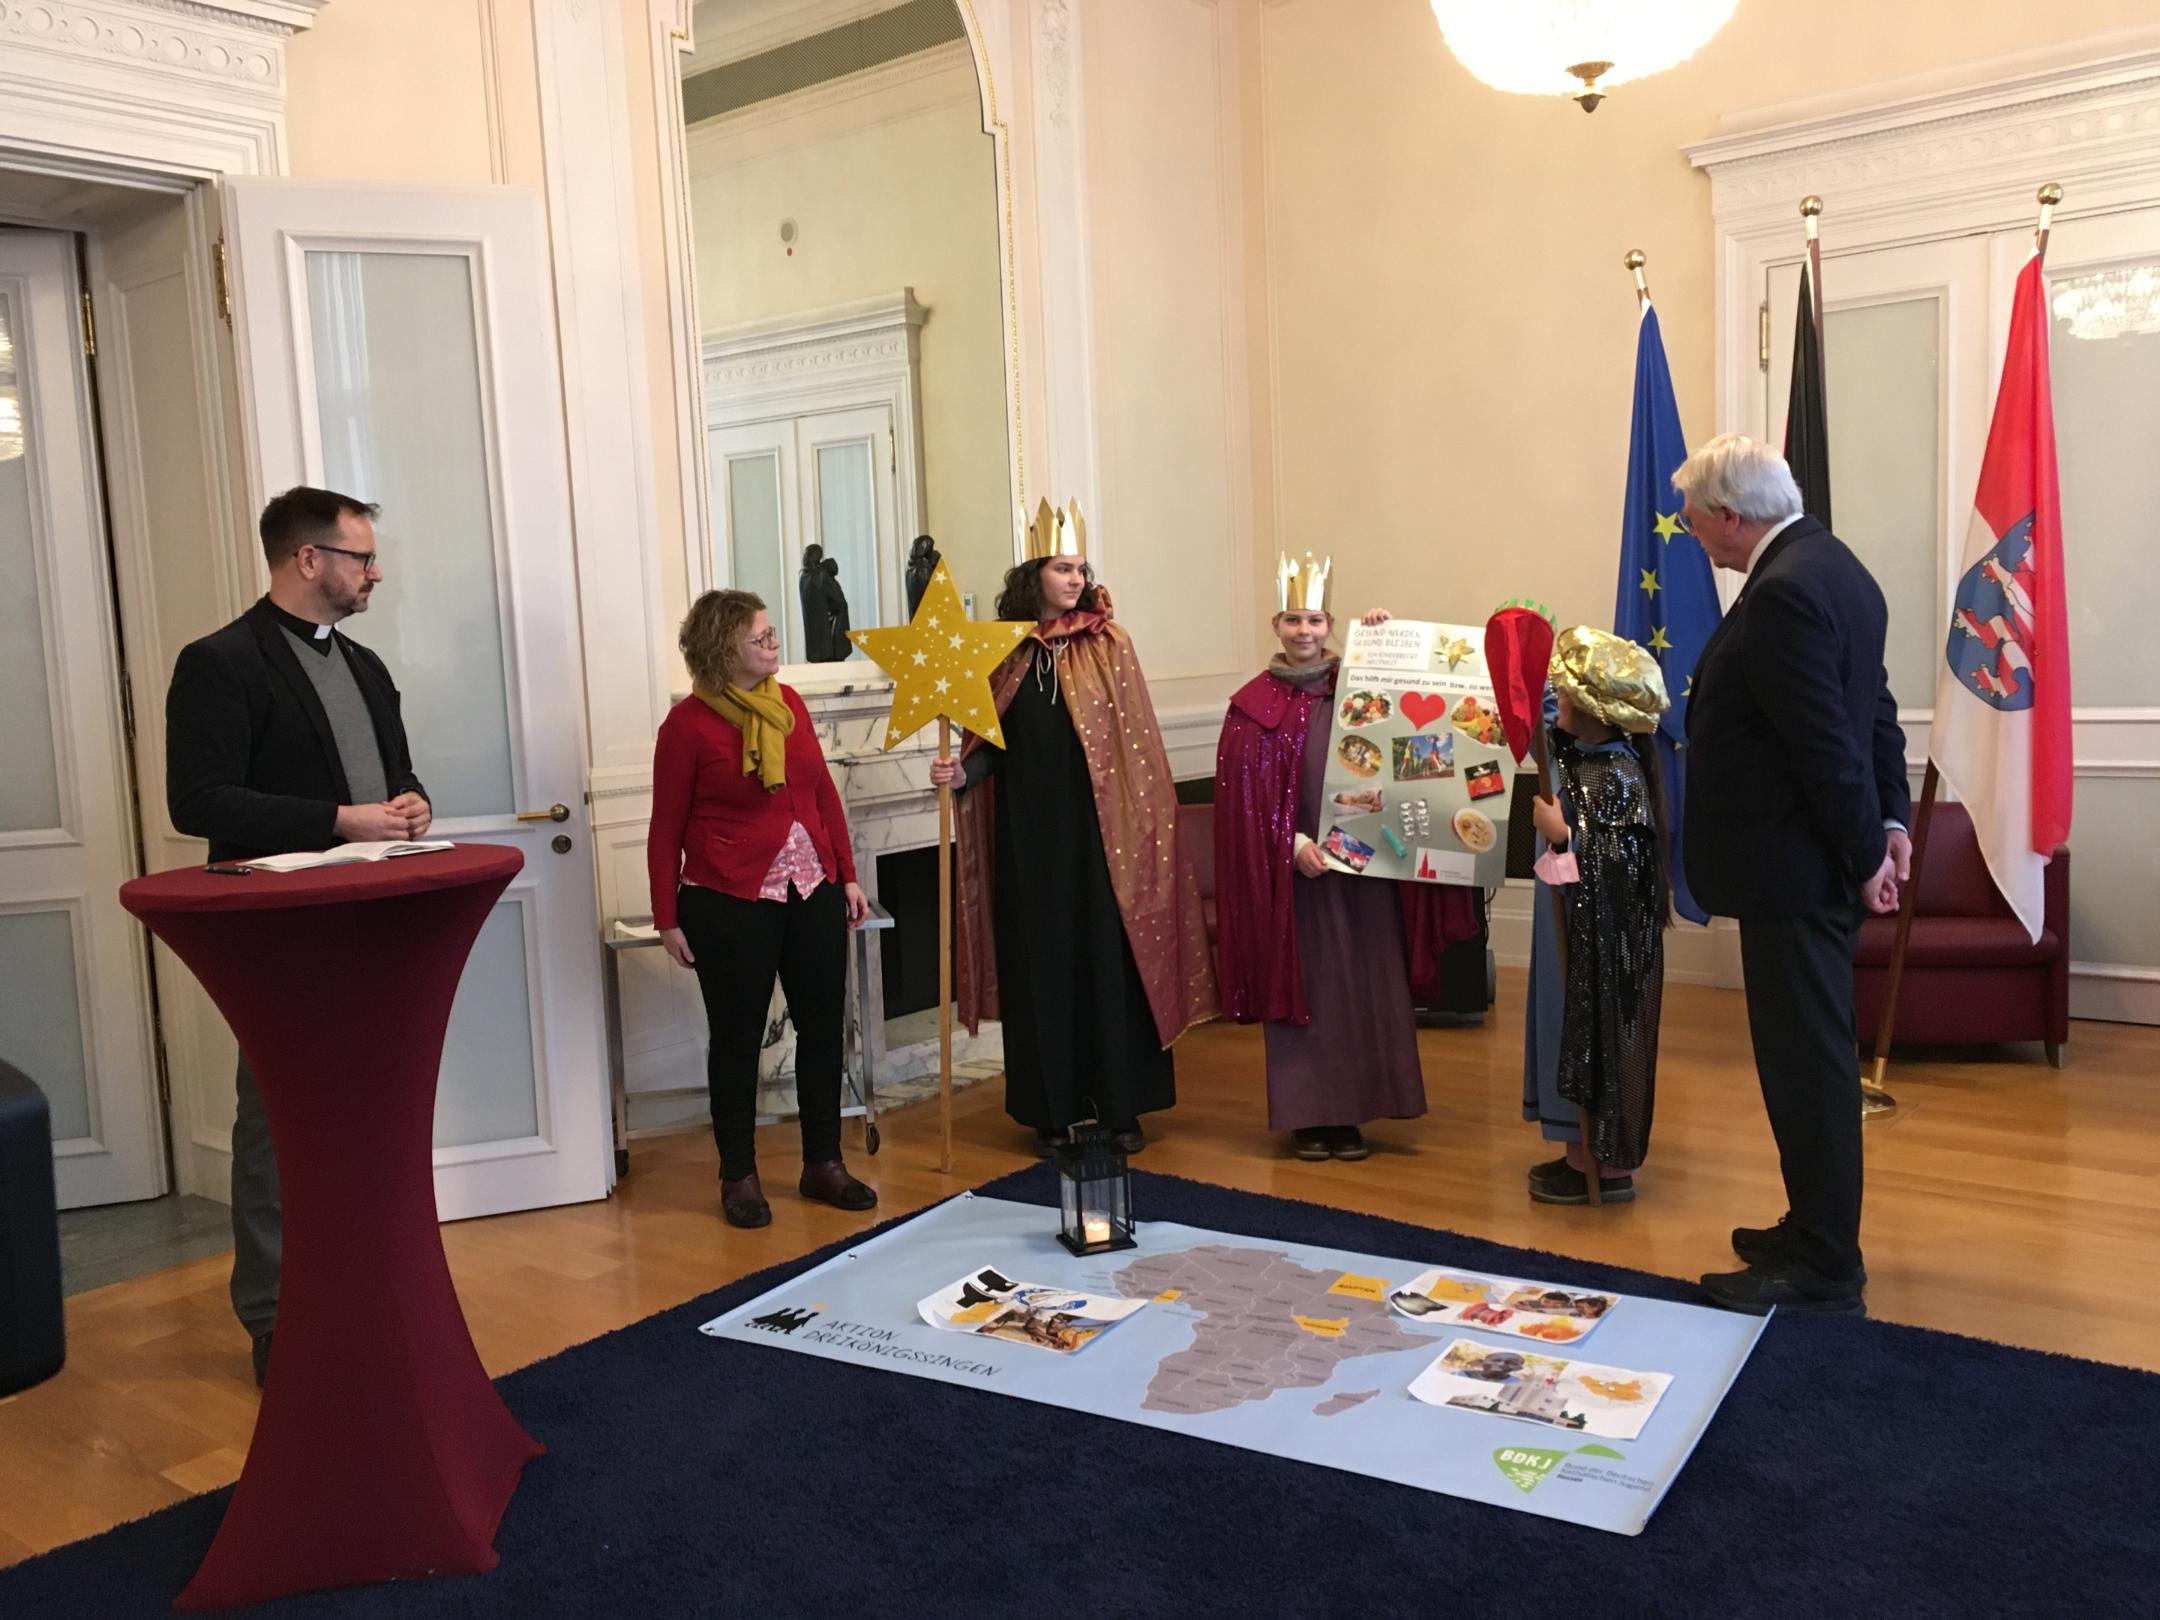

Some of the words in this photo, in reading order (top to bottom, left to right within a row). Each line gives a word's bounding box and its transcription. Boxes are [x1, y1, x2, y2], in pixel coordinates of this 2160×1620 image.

[1394, 677, 1421, 686] gesund
[823, 1320, 901, 1342] AKTION
[1500, 1449, 1553, 1469] BDKJ
